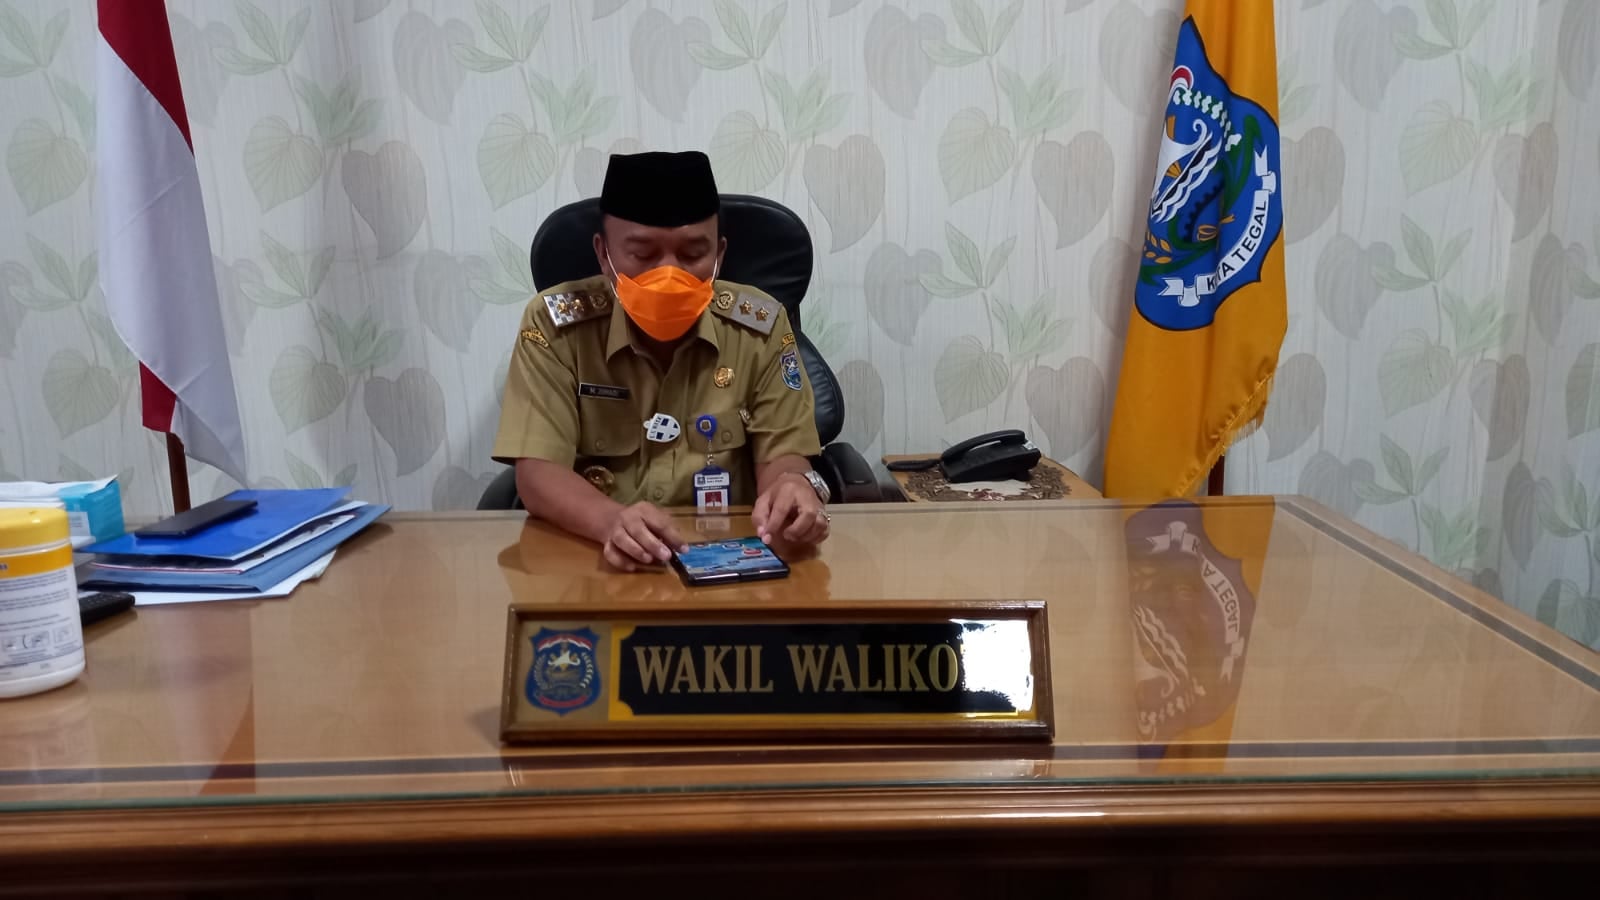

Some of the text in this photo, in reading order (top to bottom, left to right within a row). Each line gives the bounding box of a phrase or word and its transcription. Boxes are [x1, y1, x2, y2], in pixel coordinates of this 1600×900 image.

[1206, 201, 1267, 291] KTA TEGAL
[632, 643, 965, 694] WAKIL WALIKO
